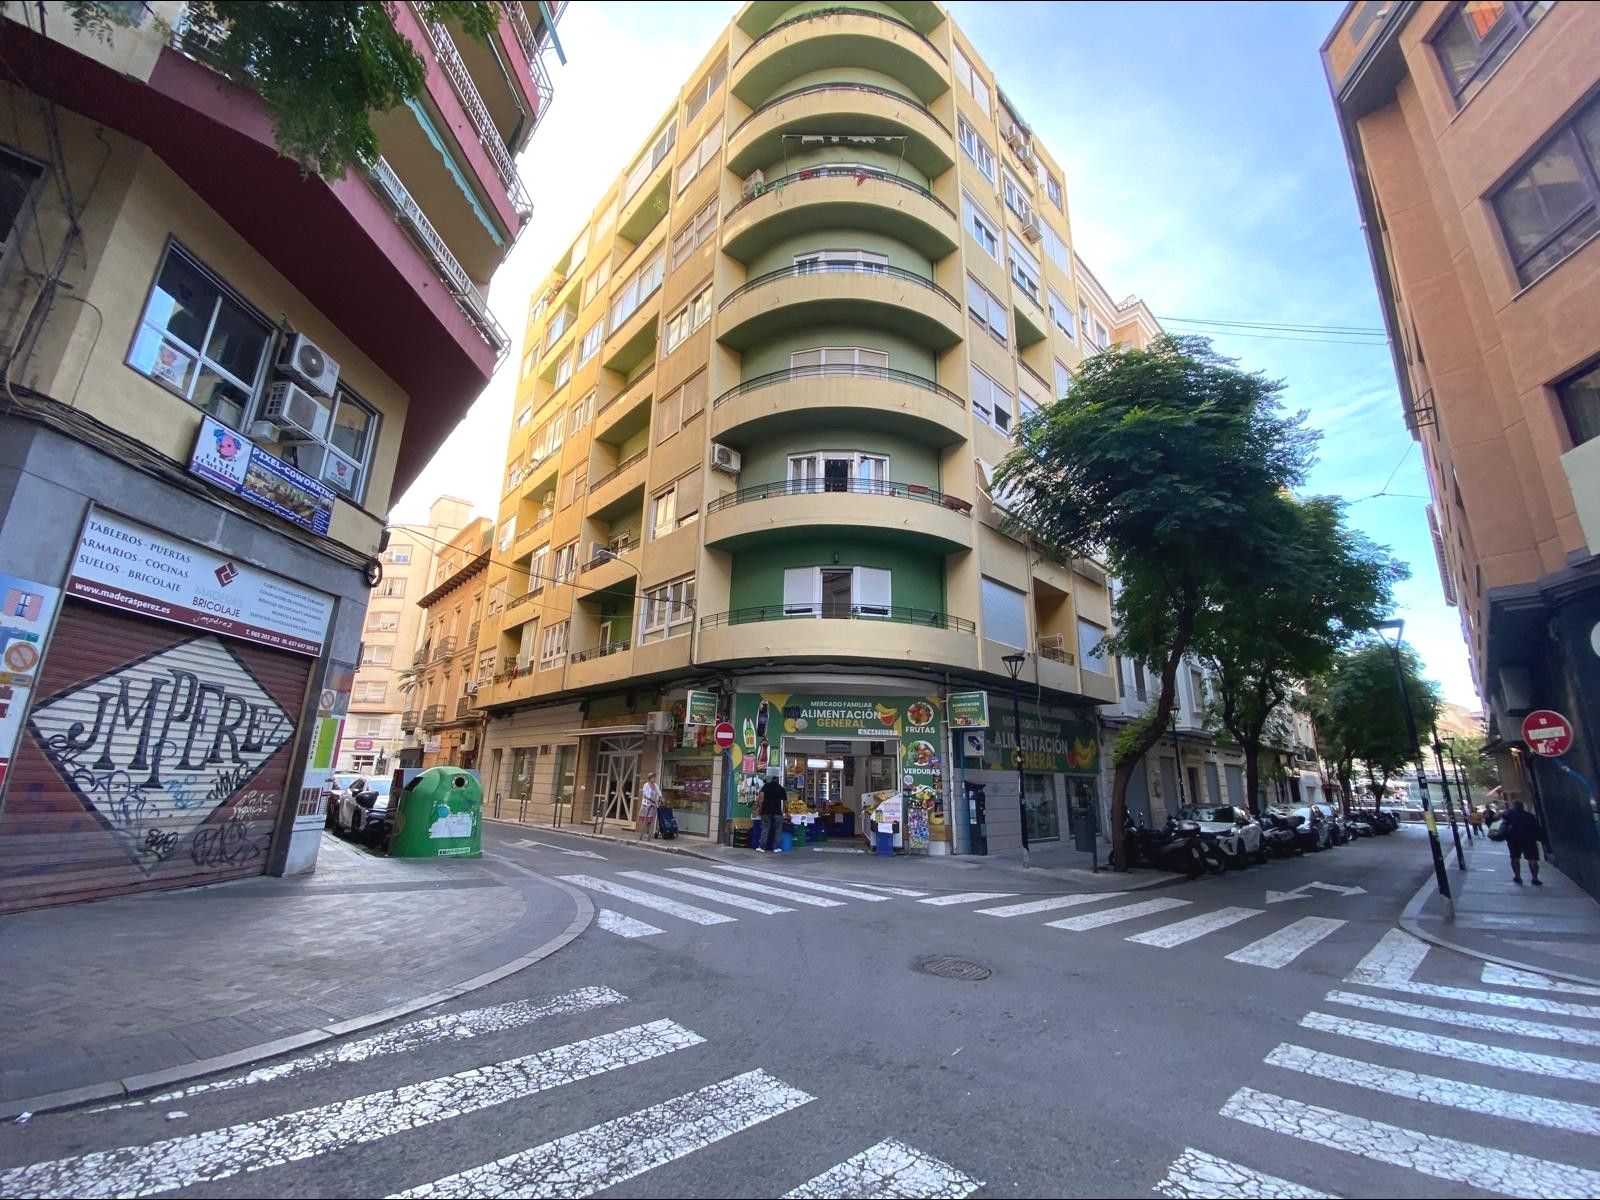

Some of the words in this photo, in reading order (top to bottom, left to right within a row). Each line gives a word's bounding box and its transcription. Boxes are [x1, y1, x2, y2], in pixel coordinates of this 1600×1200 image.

[252, 447, 335, 500] PIXEL-COWORKING
[90, 521, 143, 546] TABLEROS
[150, 543, 192, 564] PUERTAS
[81, 538, 138, 562] ARMARIOS
[145, 558, 189, 579] COCINAS
[79, 554, 121, 573] SUELOS
[128, 569, 182, 592] BRICOLAJE
[75, 582, 171, 614] www.maderasperez.es
[192, 596, 241, 618] BRICOLAJE
[800, 708, 882, 720] ALIMENTACIÓN
[816, 718, 865, 728] GENERAL
[905, 726, 936, 734] FRUTAS
[903, 767, 941, 775] VERDURAS
